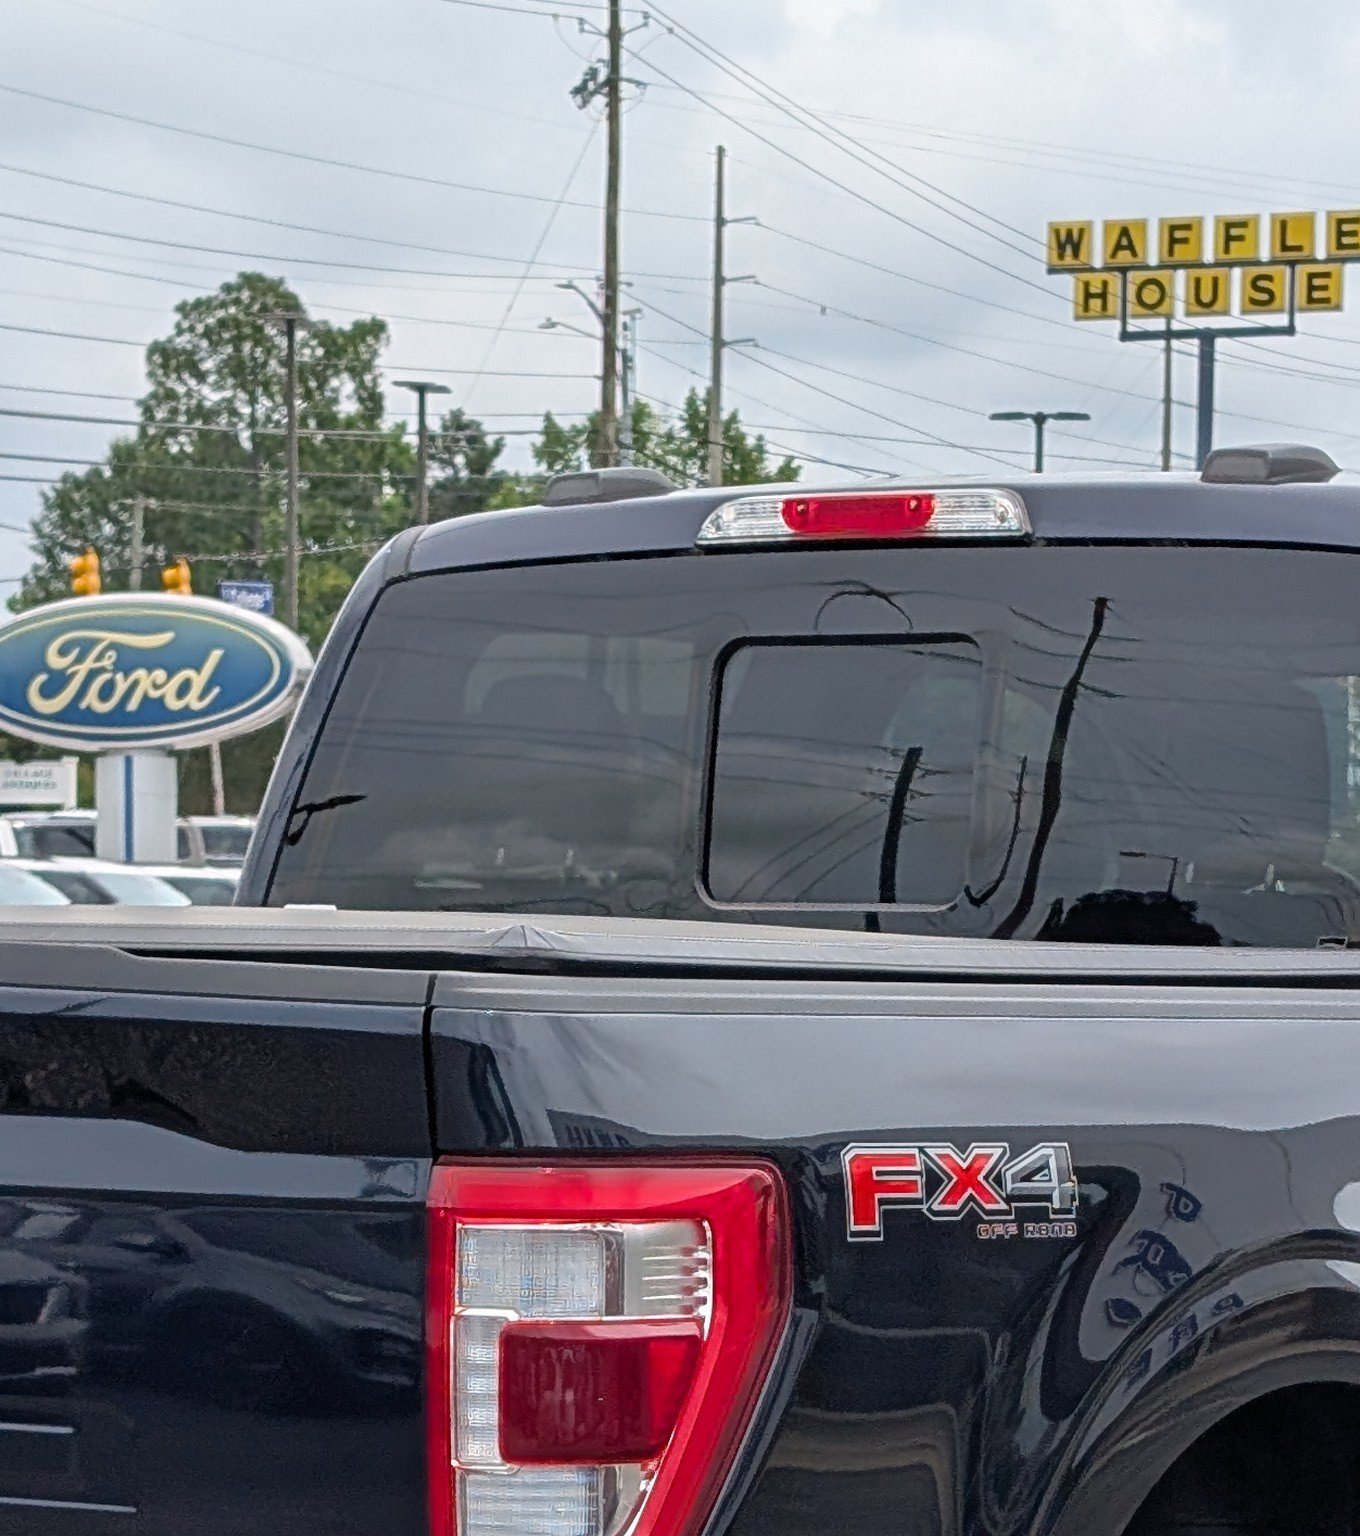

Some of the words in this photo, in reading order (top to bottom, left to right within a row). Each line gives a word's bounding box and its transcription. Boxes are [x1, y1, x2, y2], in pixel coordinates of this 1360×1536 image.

[1082, 271, 1332, 314] HOUSE
[26, 629, 226, 715] Ford
[840, 1142, 1079, 1242] FX4
